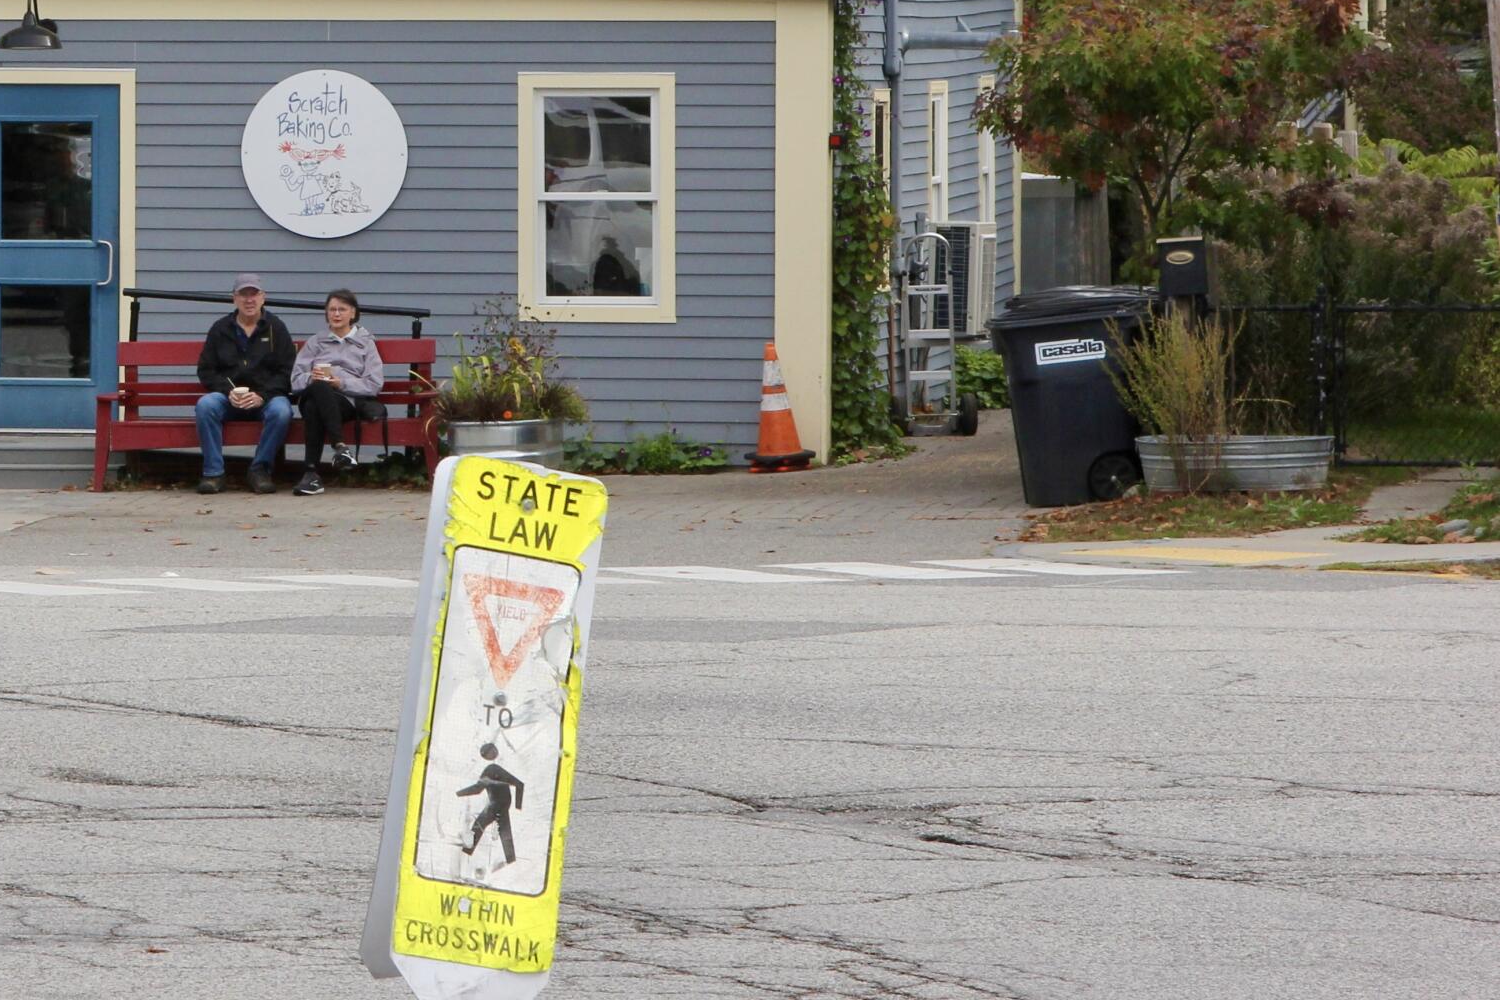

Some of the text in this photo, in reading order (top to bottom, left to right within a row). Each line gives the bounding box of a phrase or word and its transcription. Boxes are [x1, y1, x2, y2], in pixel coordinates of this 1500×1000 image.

[288, 82, 348, 116] Scratch
[277, 112, 353, 145] Baking Co.
[1042, 341, 1103, 358] casella
[477, 471, 582, 517] STATE
[489, 512, 558, 551] LAW
[496, 604, 527, 622] YIELD
[483, 704, 513, 729] TO
[406, 920, 540, 964] CROSSWALK
